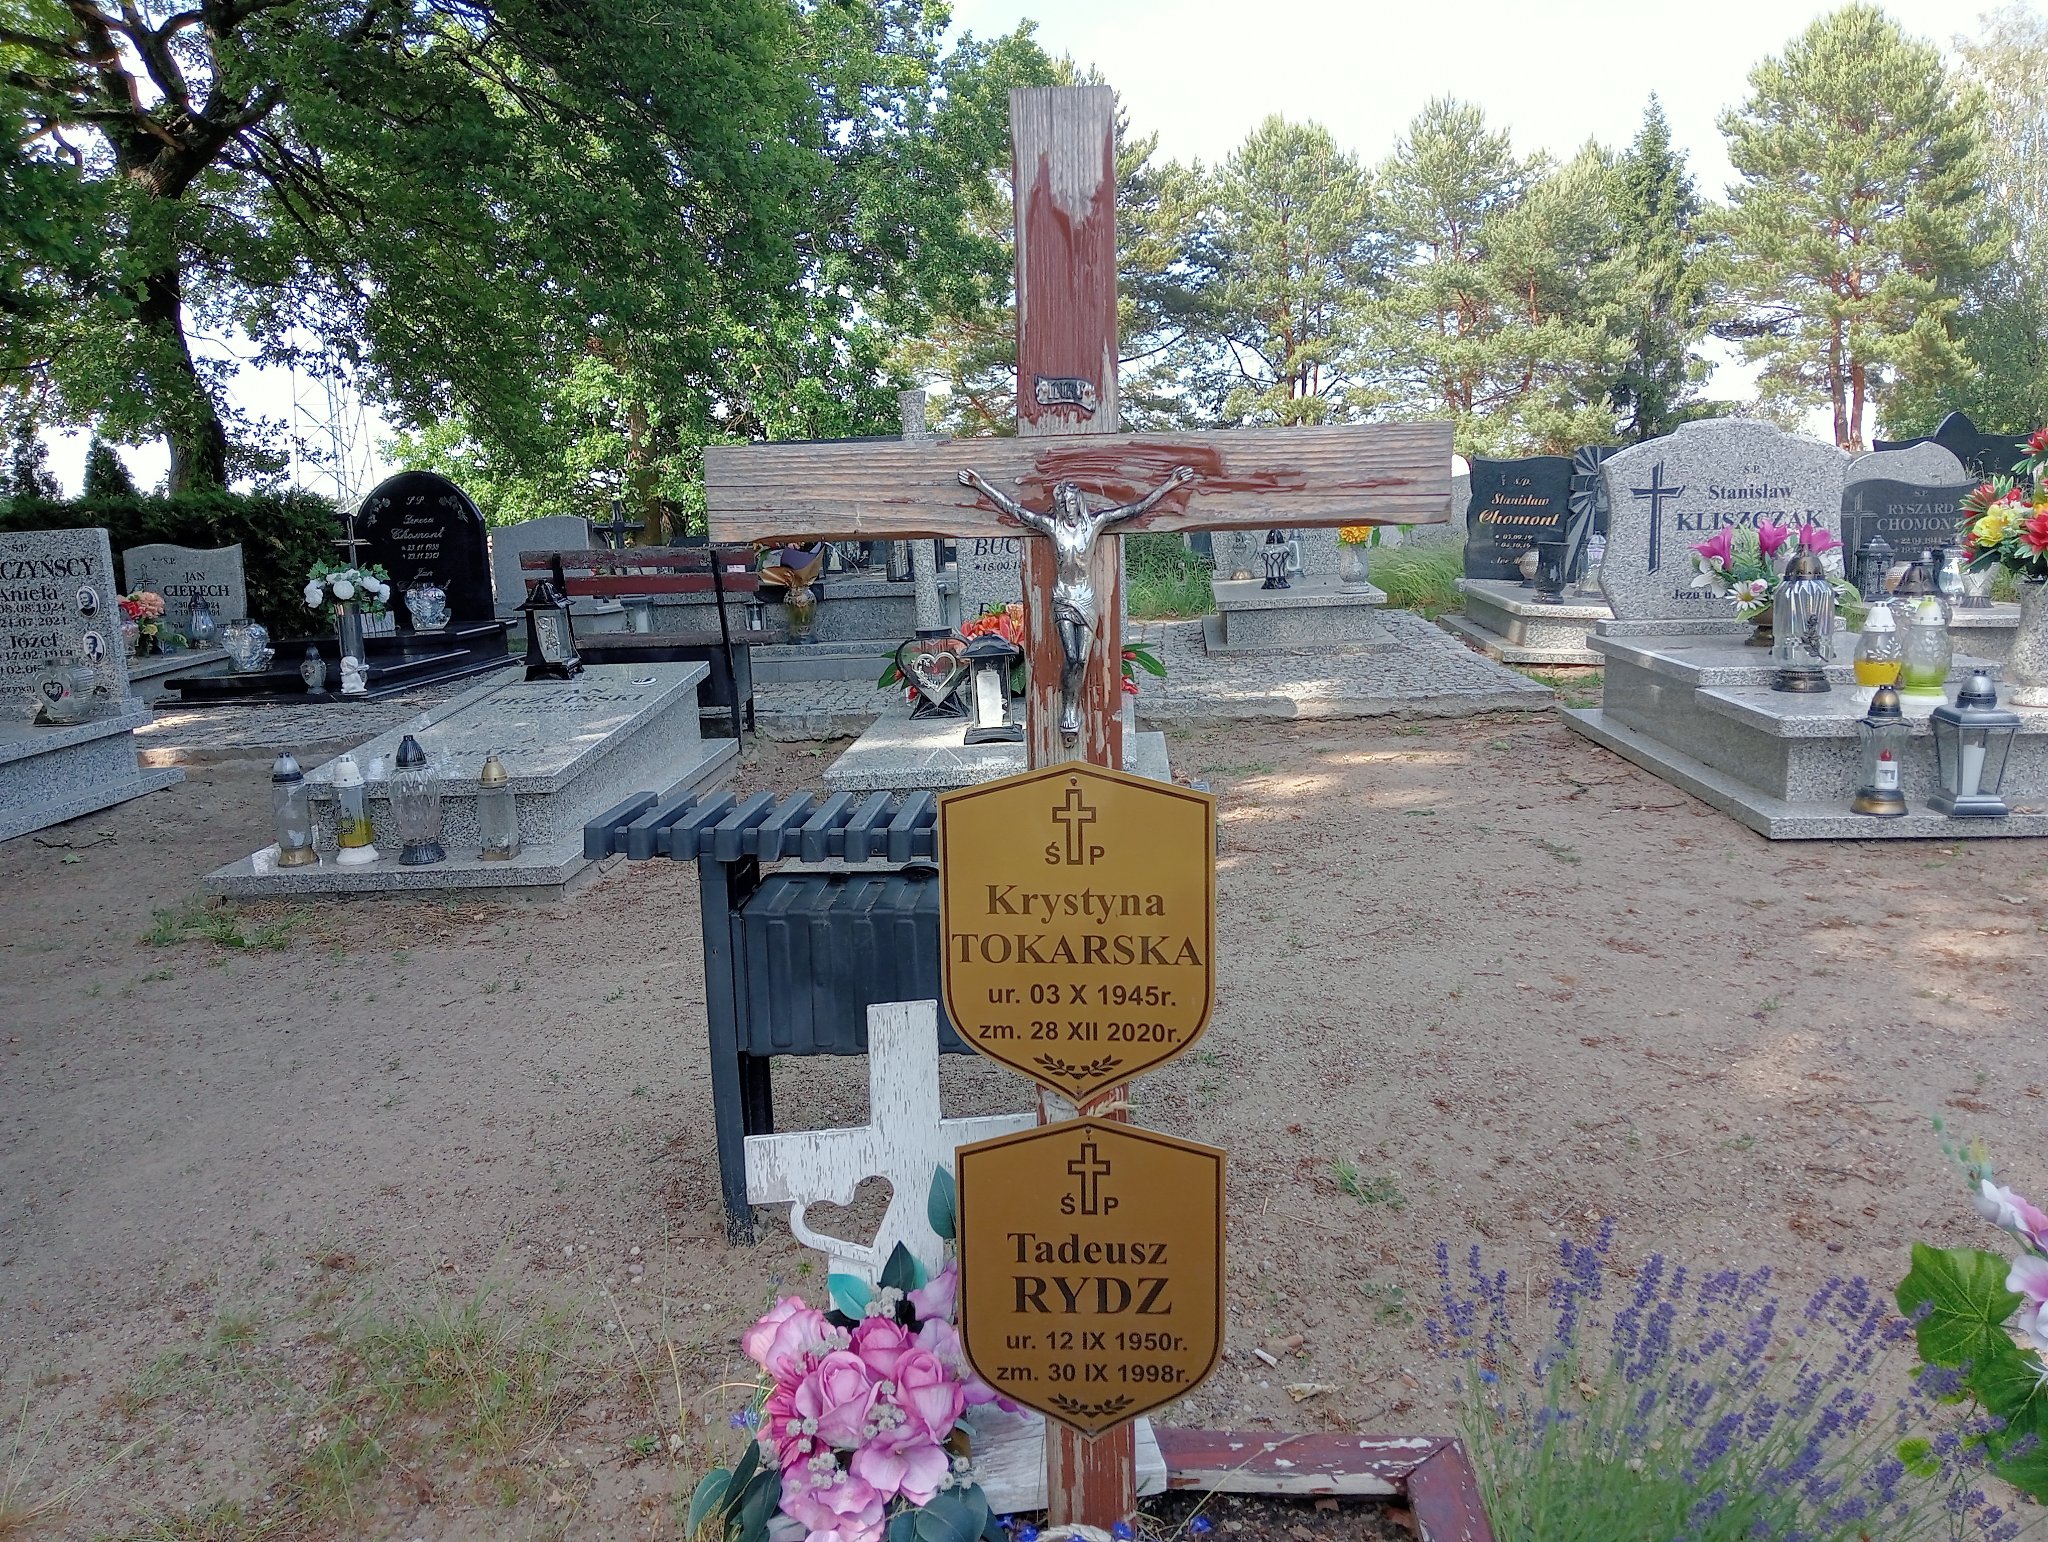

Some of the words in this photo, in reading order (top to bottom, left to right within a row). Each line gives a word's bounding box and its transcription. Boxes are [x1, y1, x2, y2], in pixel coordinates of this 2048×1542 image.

[1707, 483, 1795, 500] Stanisław
[1478, 508, 1560, 526] Chomont
[1676, 510, 1823, 531] KLISZCZAK
[1887, 503, 1955, 516] RYSZARD
[0, 553, 94, 580] CZYŃSCY
[184, 571, 206, 584] JAN
[1045, 841, 1061, 865] Ś
[1089, 845, 1105, 866] P
[985, 884, 1166, 924] Krystyna
[951, 933, 1203, 966] TOKARSKA
[988, 986, 1021, 1005] ur.
[1030, 984, 1061, 1005] 03
[1069, 984, 1088, 1006] X
[1097, 985, 1177, 1007] 1945r.
[978, 1022, 1022, 1040] zm.
[1030, 1021, 1059, 1041] 28
[1067, 1021, 1098, 1042] XII
[1107, 1022, 1182, 1043] 2020r.
[1060, 1193, 1076, 1215] Ś
[1104, 1197, 1119, 1216] P
[1007, 1232, 1168, 1265] Tadeusz
[1010, 1275, 1173, 1315] RYDZ
[1006, 1333, 1037, 1350] ur.
[1047, 1332, 1073, 1351] 12
[1082, 1332, 1106, 1351] IX
[1115, 1333, 1189, 1352] 1950r.
[997, 1364, 1039, 1381] zm.
[1048, 1363, 1076, 1382] 30
[1085, 1364, 1109, 1383] IX
[1117, 1364, 1190, 1384] 1998r.
